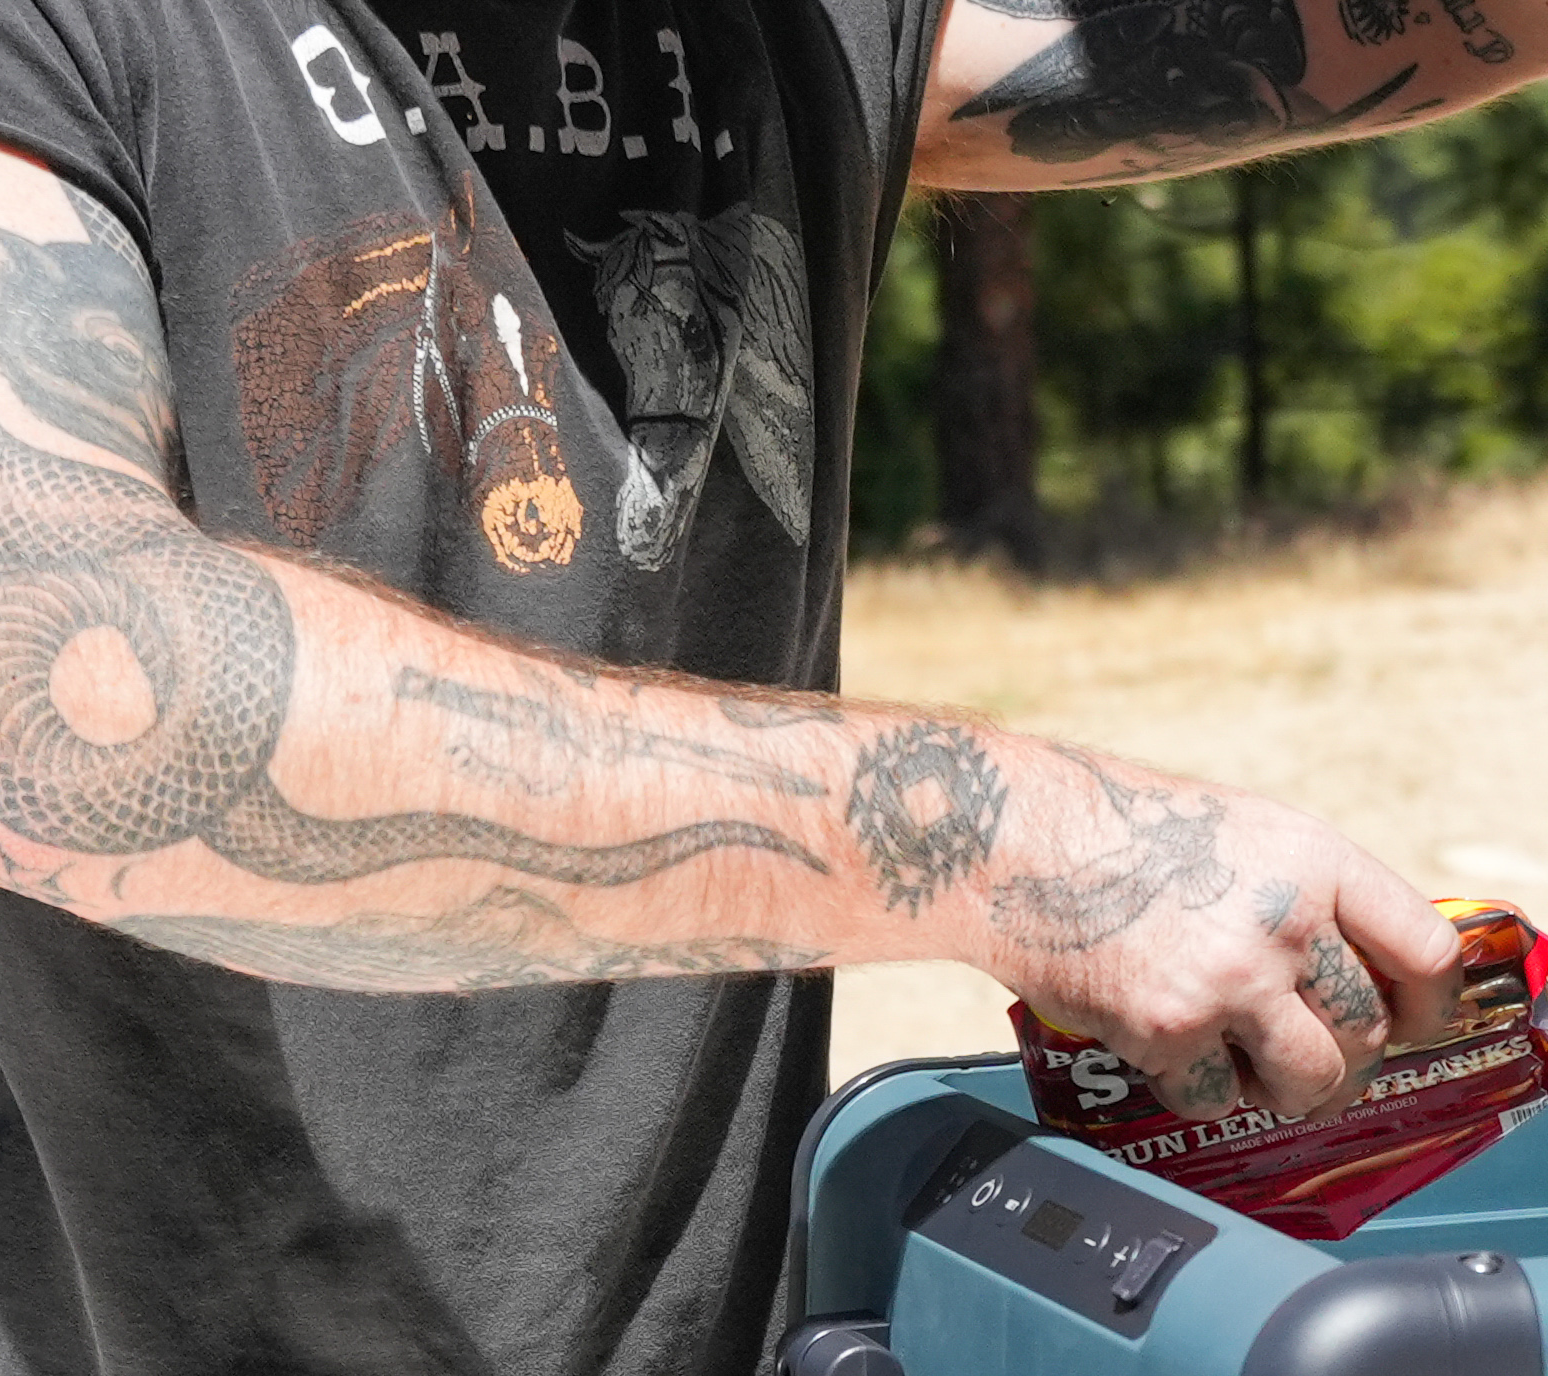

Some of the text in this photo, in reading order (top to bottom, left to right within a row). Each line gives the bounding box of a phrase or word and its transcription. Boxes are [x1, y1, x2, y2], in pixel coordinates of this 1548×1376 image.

[1104, 1129, 1188, 1166] BUN
[1370, 1034, 1533, 1102] FRANKS
[1229, 1135, 1263, 1153] MADE
[1264, 1127, 1294, 1144] WITH
[1347, 1106, 1379, 1122] PORK
[1380, 1095, 1418, 1114] ADDED
